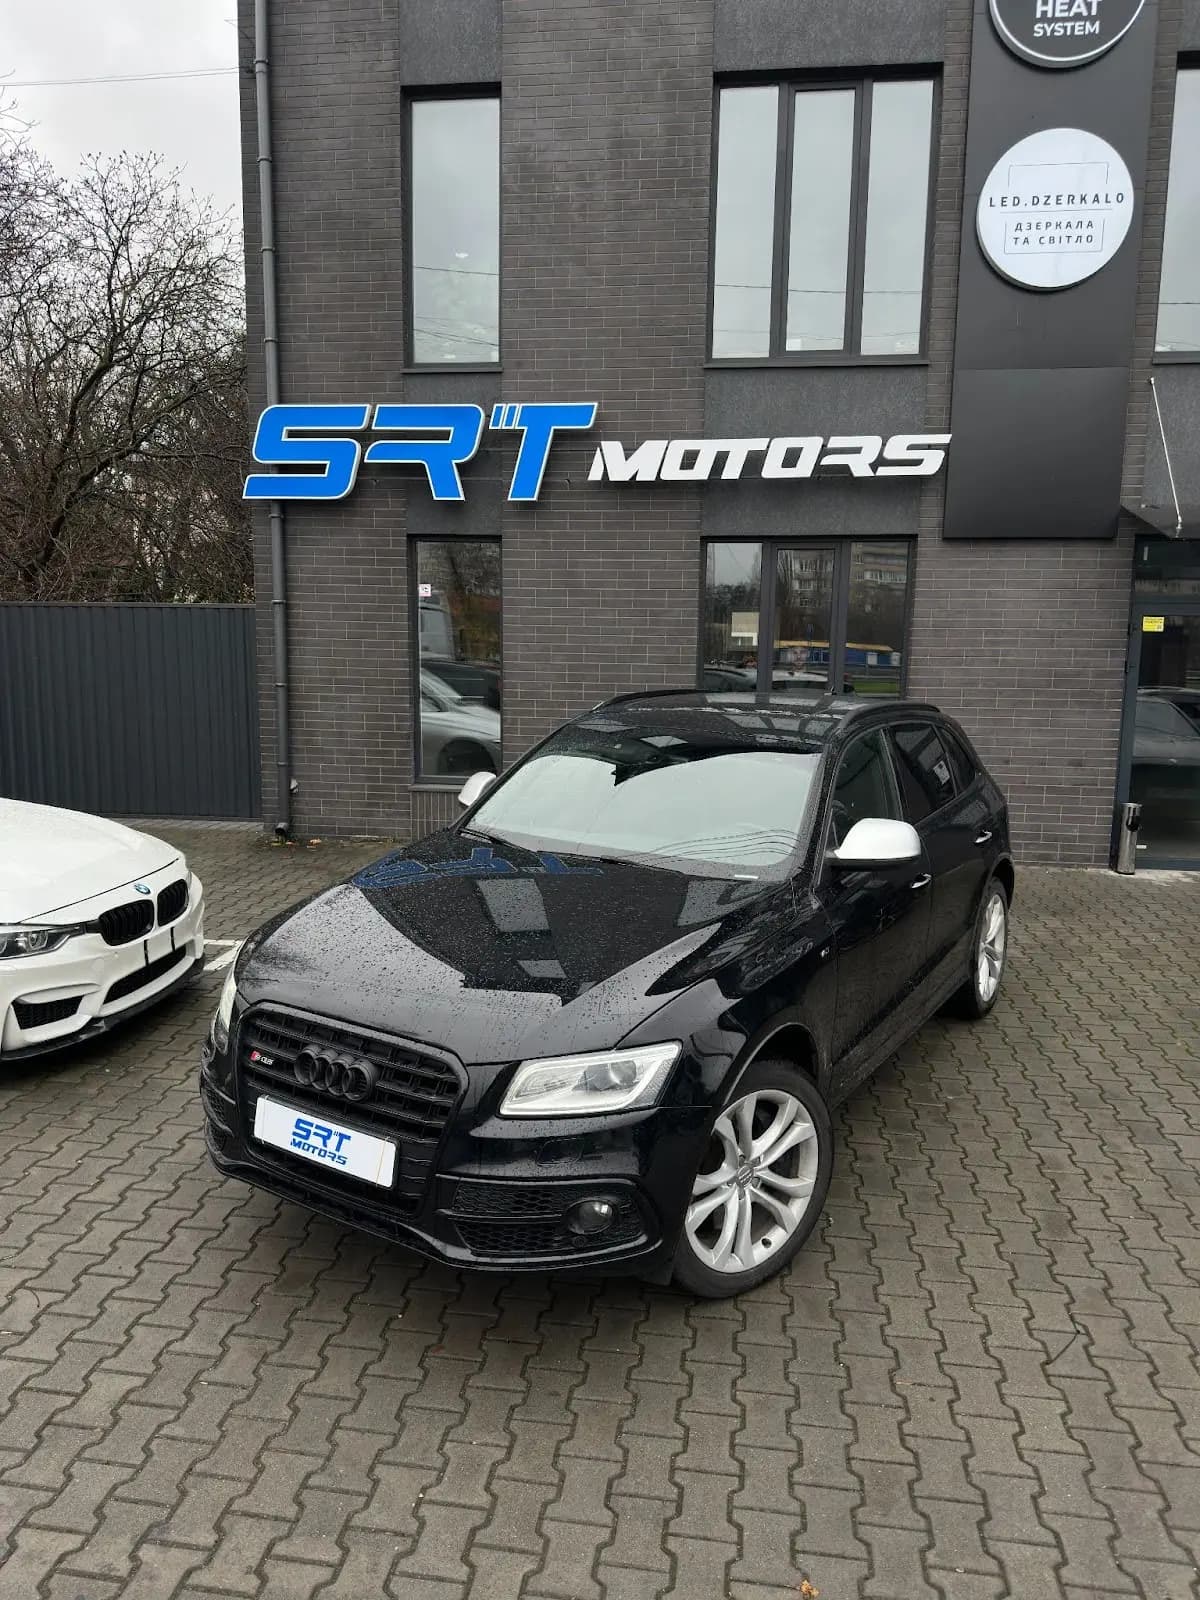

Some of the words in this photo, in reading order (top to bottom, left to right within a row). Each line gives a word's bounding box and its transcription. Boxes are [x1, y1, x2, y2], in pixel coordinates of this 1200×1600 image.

[1035, 0, 1101, 18] HEAT
[1033, 20, 1100, 37] SYSTEM
[989, 192, 1125, 208] LED.DZERKALO
[1014, 220, 1094, 232] ДЗЕРКАЛА
[1013, 236, 1030, 246] ТА
[1038, 234, 1094, 245] СВІТЛО
[242, 402, 599, 502] SRT
[587, 433, 953, 482] MOTORS
[291, 1118, 352, 1153] SRT
[290, 1138, 348, 1166] MOTORS
